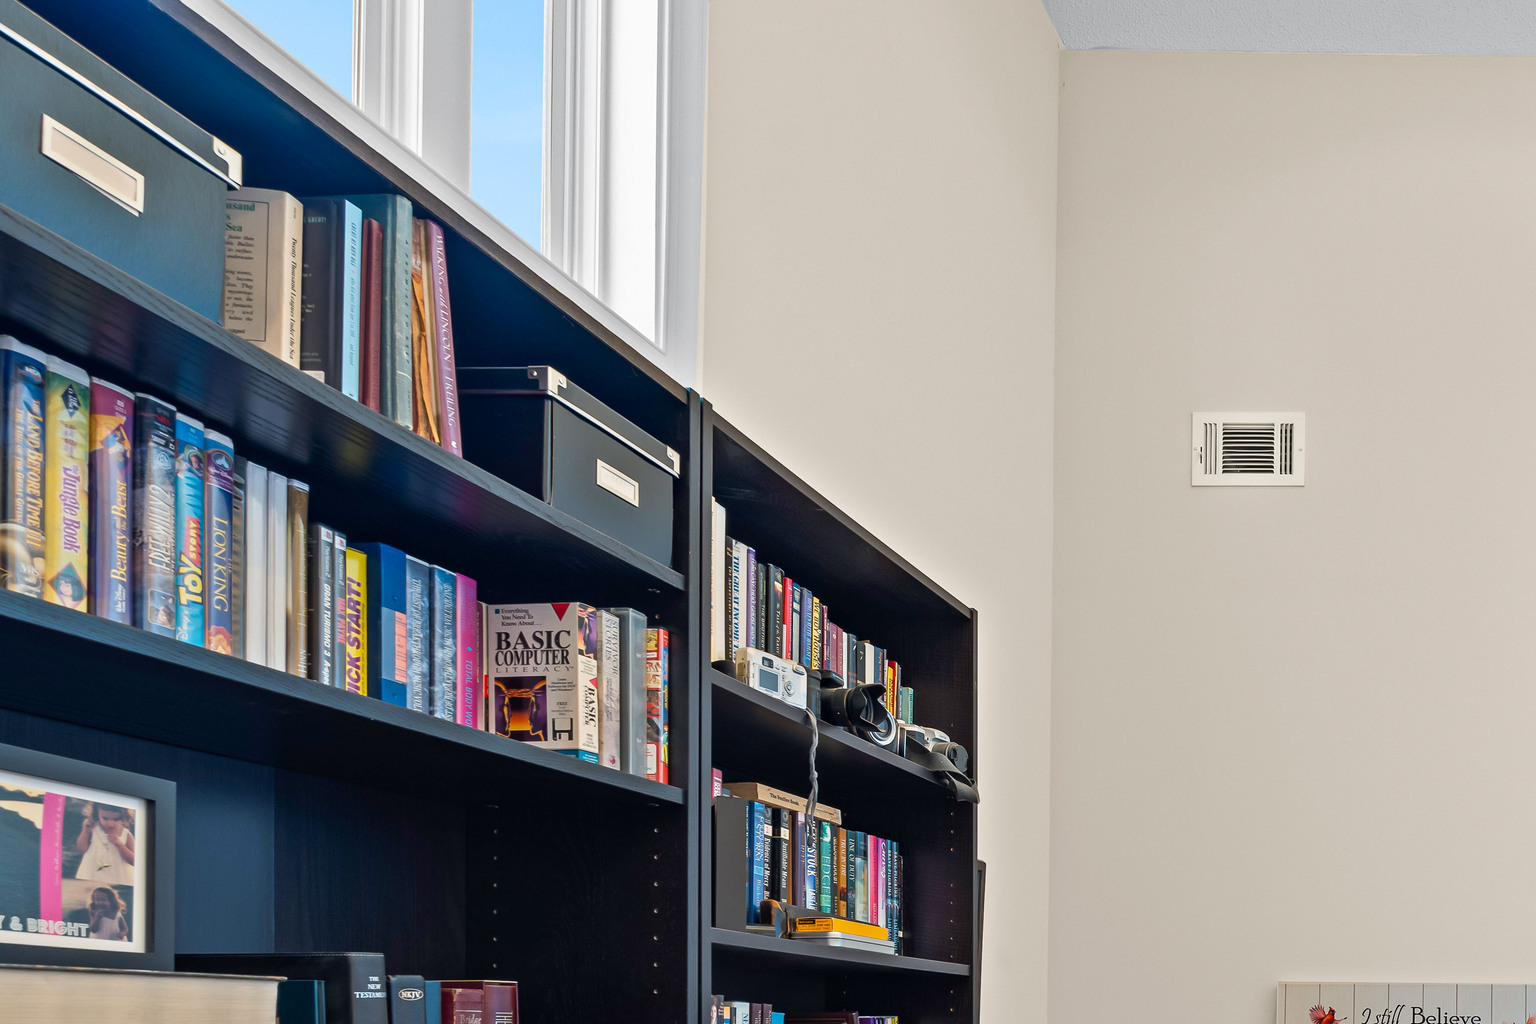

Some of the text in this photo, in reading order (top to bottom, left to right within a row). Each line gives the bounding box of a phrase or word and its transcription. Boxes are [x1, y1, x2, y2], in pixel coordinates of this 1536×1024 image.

[290, 262, 298, 291] Thousand
[436, 235, 445, 286] WALKING
[438, 287, 449, 307] with
[440, 307, 452, 362] LINCOLN
[26, 412, 43, 449] LAND
[26, 449, 43, 496] BEFORE
[59, 466, 81, 517] Jungle
[26, 496, 43, 529] TIME
[110, 480, 127, 519] Beast
[63, 516, 81, 554] Book
[148, 484, 173, 573] FREE WILLY 2
[110, 530, 130, 583] Beauty
[177, 520, 203, 606] TOY STORY
[213, 515, 230, 612] LION KING
[337, 597, 346, 645] MAX PAYNE
[501, 607, 530, 616] Everything
[495, 630, 571, 651] BASIC
[495, 649, 571, 667] COMPUTER
[605, 617, 613, 661] STORIES
[612, 619, 620, 676] SURVIVOR
[465, 660, 473, 708] TOTAL BODY
[588, 687, 597, 728] BASIC
[10, 916, 23, 932] &
[26, 917, 90, 937] BRIGHT
